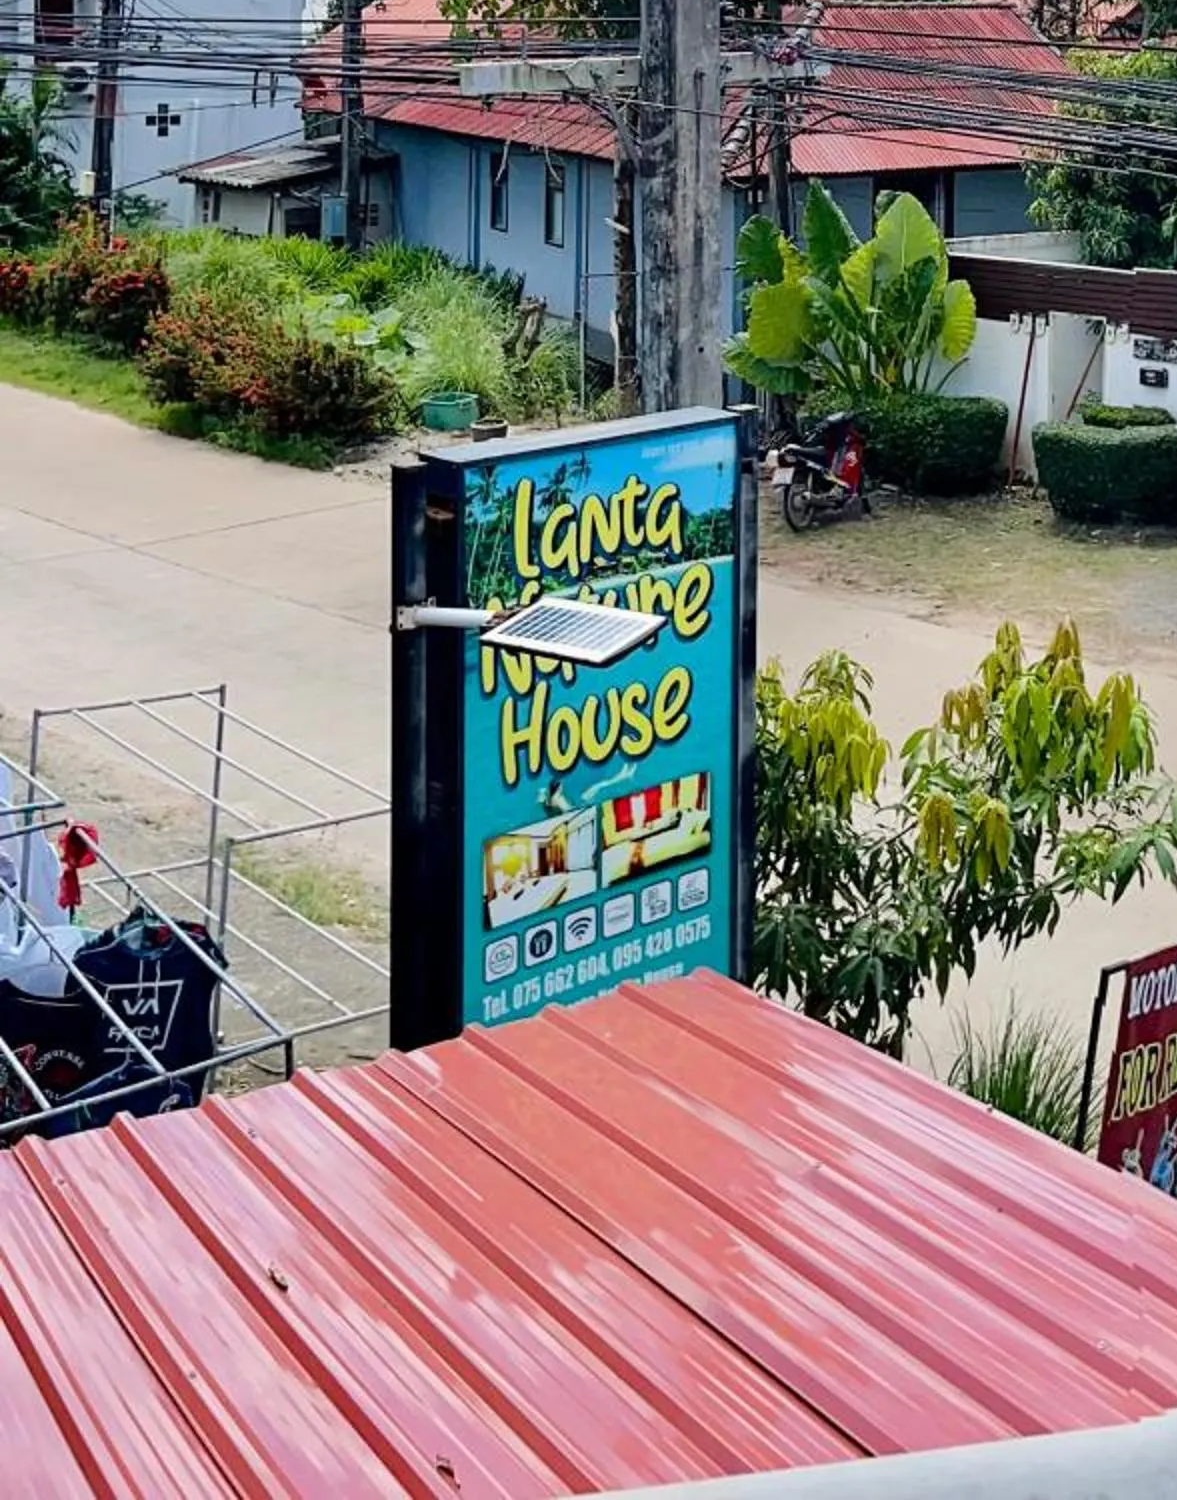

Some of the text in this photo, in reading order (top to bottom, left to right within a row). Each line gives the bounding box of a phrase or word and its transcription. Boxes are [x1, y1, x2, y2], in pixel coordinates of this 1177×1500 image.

[512, 472, 684, 580] Lanta
[501, 666, 692, 786] House
[512, 976, 541, 1010] 075
[543, 964, 575, 997] 662
[613, 938, 642, 972] 095
[675, 914, 711, 948] 0575
[1111, 1042, 1162, 1121] FOR
